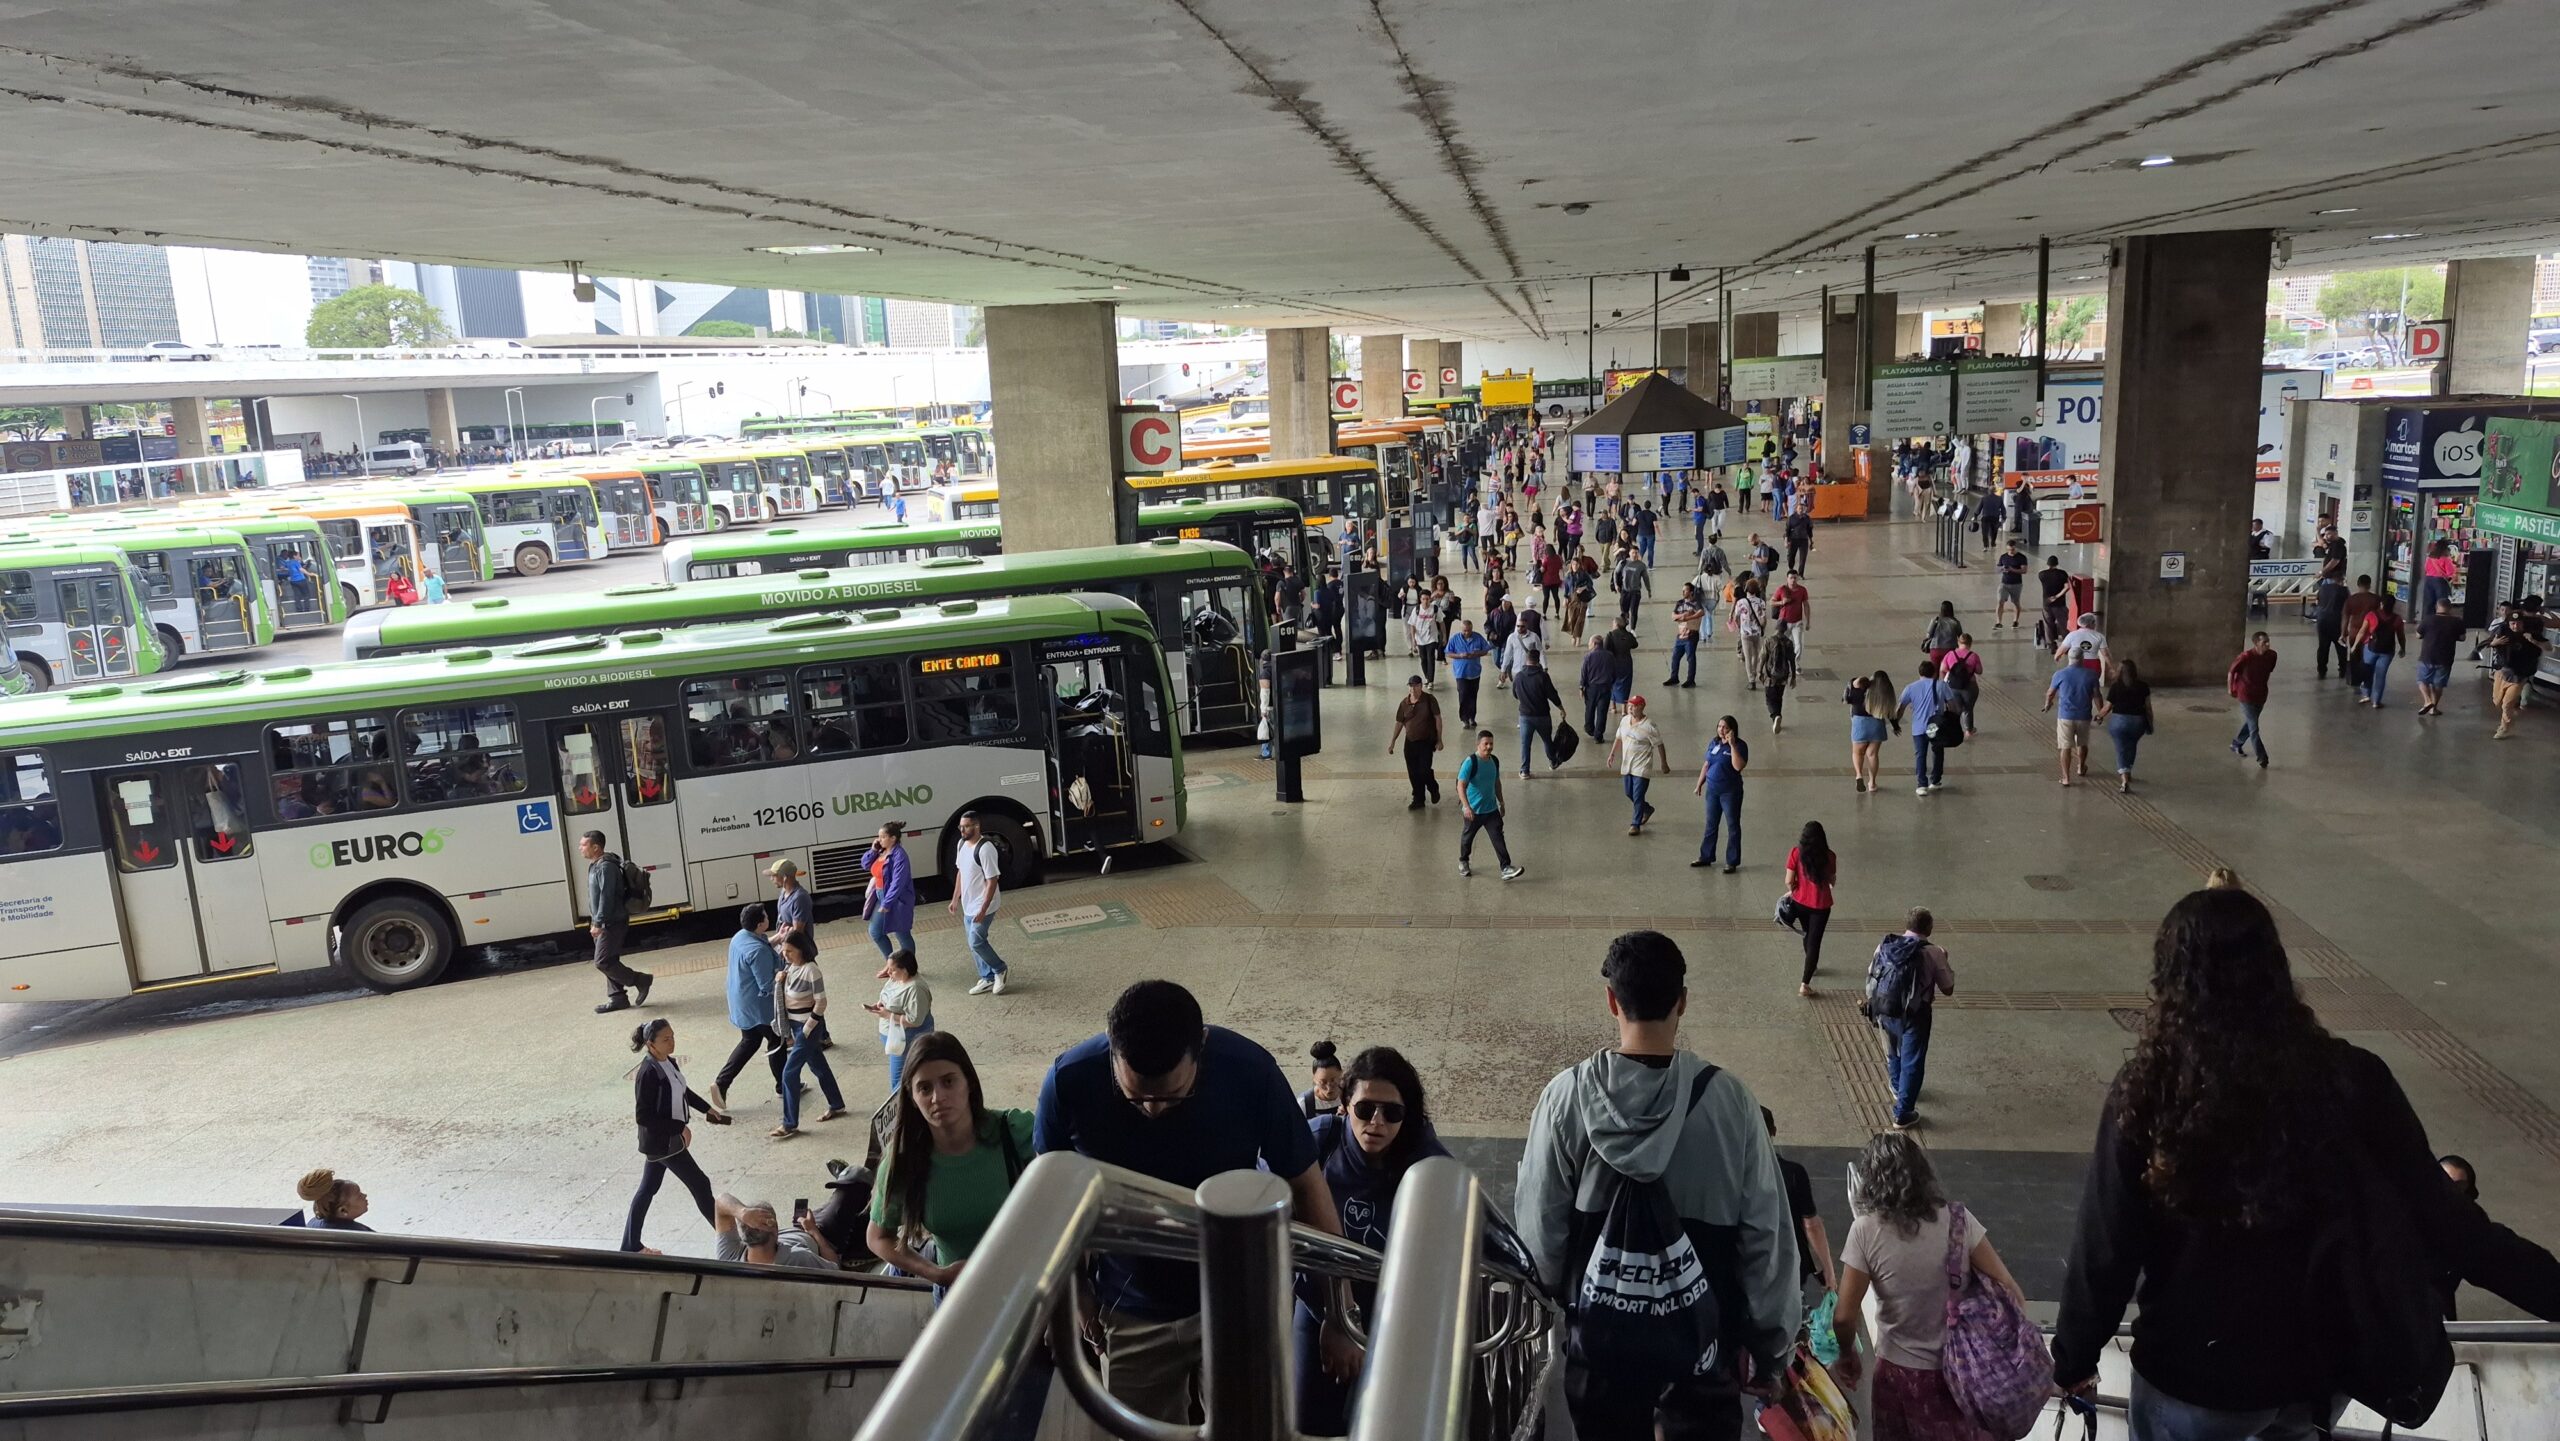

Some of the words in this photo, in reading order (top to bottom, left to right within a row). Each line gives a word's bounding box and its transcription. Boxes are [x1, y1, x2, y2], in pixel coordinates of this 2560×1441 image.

[1967, 336, 1980, 349] D
[2412, 328, 2440, 355] D
[1881, 366, 1932, 375] PLATAFORMA
[1935, 364, 1942, 372] C
[1968, 361, 2019, 370] PLATAFORMA
[1407, 373, 1423, 390] C
[1443, 369, 1455, 382] C
[1336, 384, 1358, 409] C
[2057, 396, 2102, 424] PO
[1130, 418, 1172, 465] C
[2442, 445, 2474, 461] iOS
[1174, 474, 1214, 483] BIODIESEL
[959, 528, 998, 539] MOVIDO
[2291, 564, 2307, 573] DF
[1186, 577, 1211, 585] ENTRADA
[1213, 574, 1241, 582] ENTRANCE
[761, 588, 824, 605] MOVIDO
[828, 588, 838, 599] A
[842, 579, 923, 597] BIODIESEL
[1280, 627, 1286, 636] C
[1046, 650, 1079, 660] ENTRADA
[1083, 645, 1121, 656] ENTRANCE
[544, 674, 587, 688] MOVIDO
[590, 675, 598, 684] A
[600, 669, 656, 682] BIODIESEL
[572, 702, 602, 714] SAÍDA
[608, 699, 630, 710] EXIT
[125, 750, 160, 762] SAÍDA
[167, 747, 192, 758] EXIT
[753, 801, 825, 826] 121606
[831, 784, 933, 816] URBANO
[712, 814, 731, 825] Área
[732, 814, 737, 822] 1
[700, 821, 750, 835] Piracicabana
[8, 910, 54, 922] Mobilidade
[1583, 1283, 1648, 1313] COMORT
[1650, 1278, 1709, 1316] INCLDED
